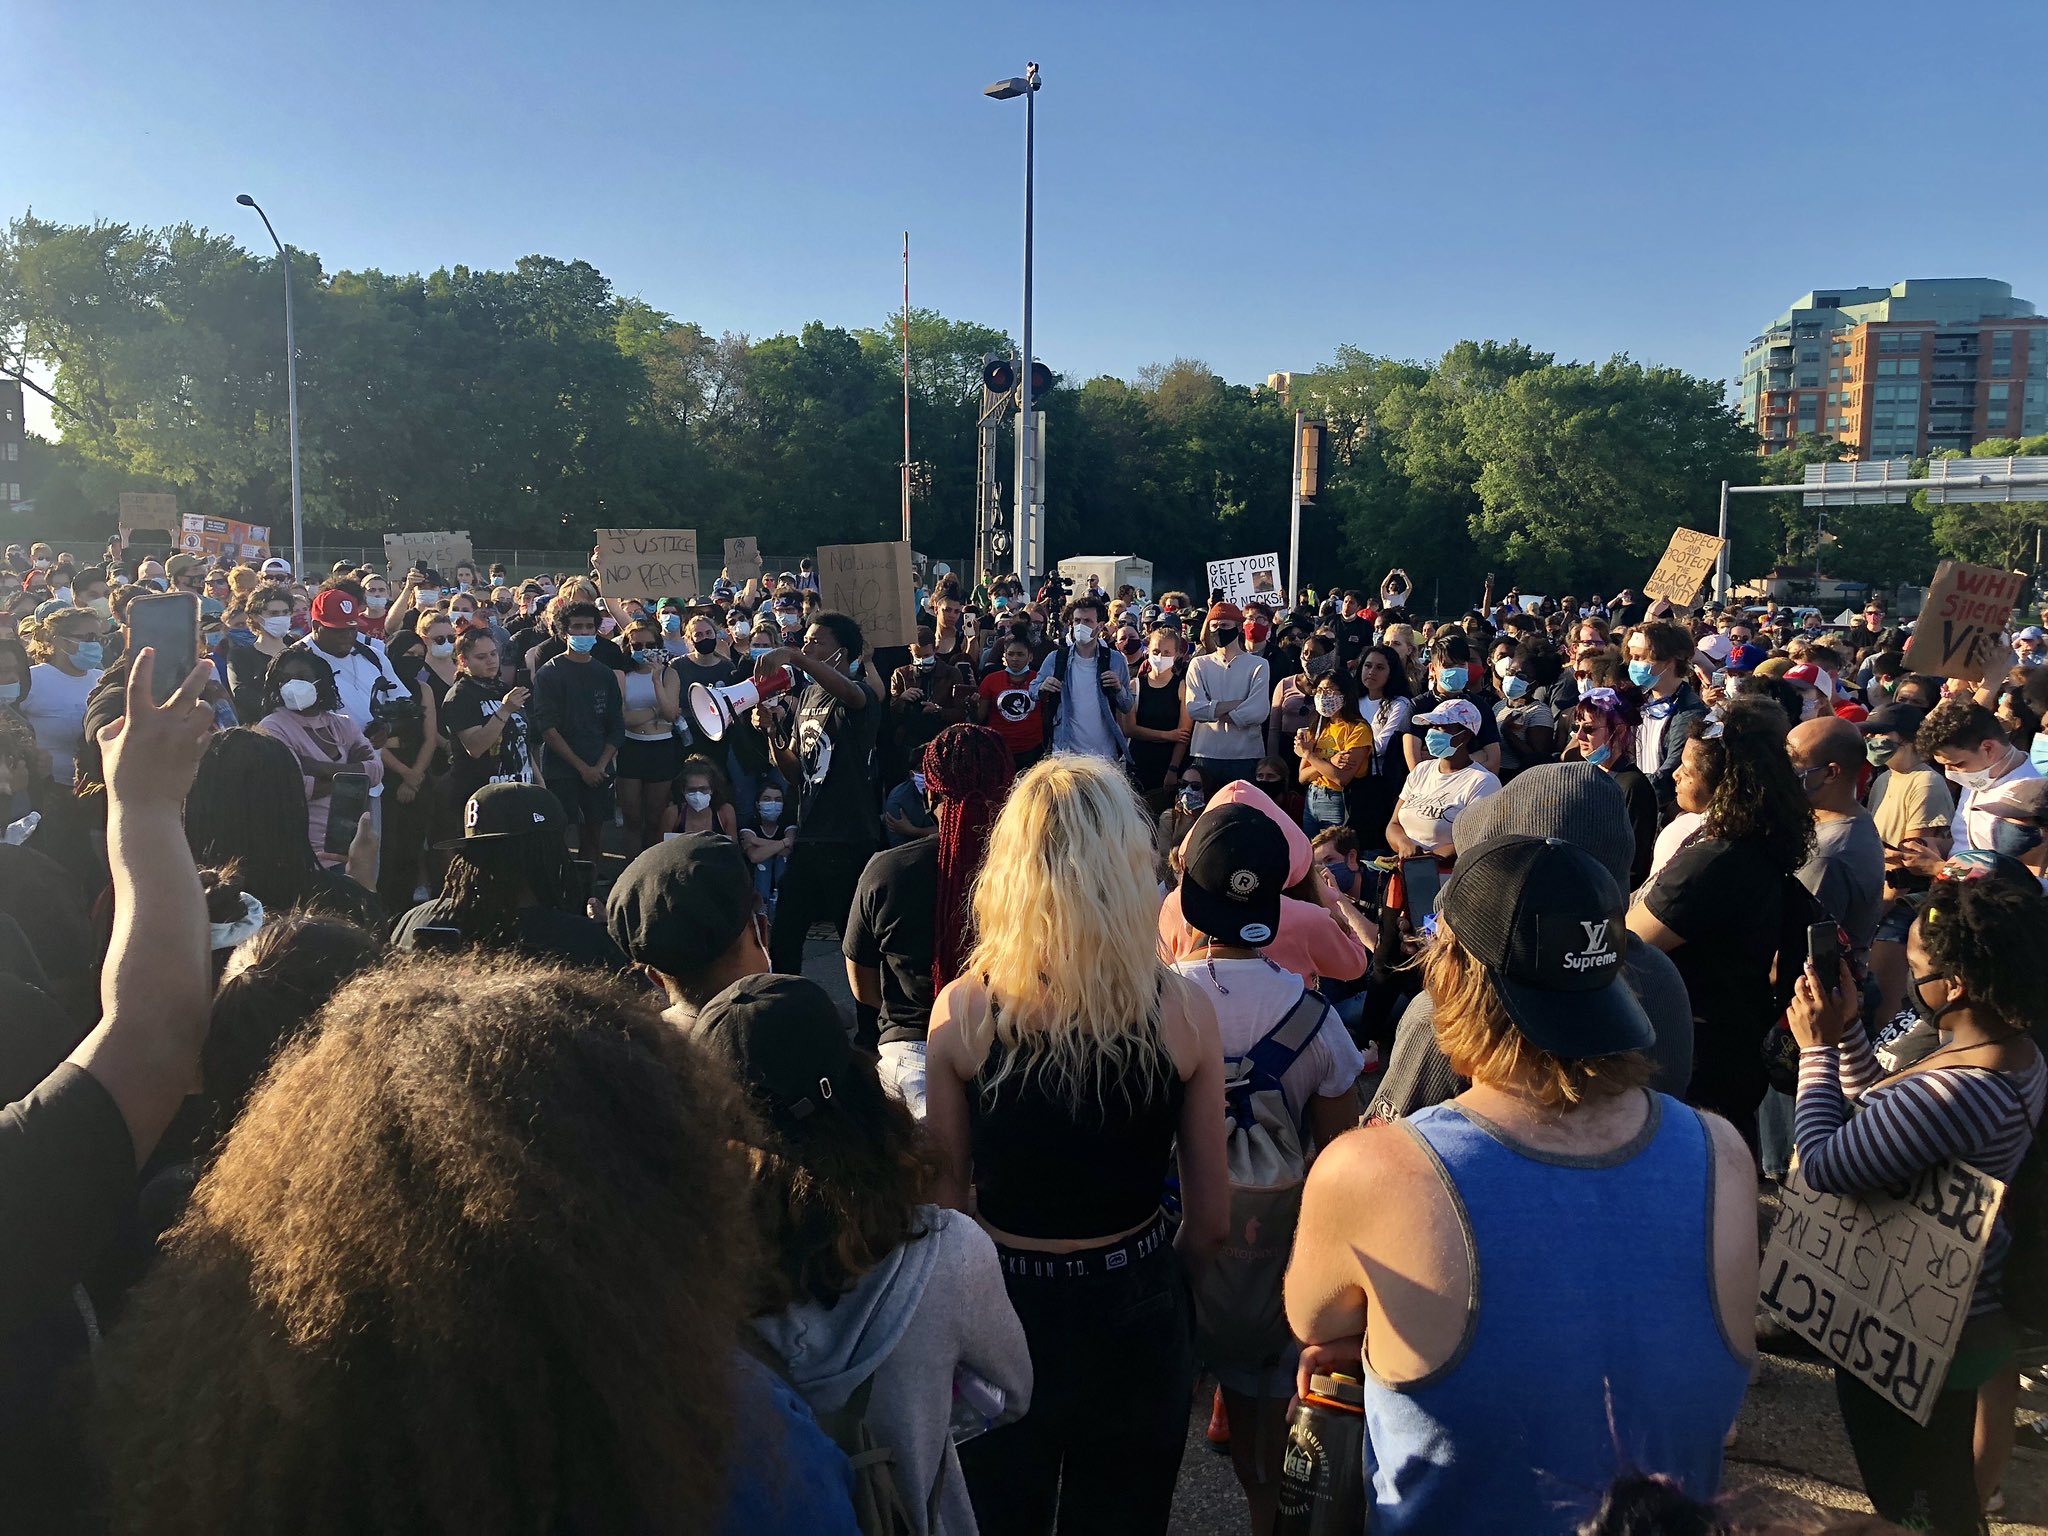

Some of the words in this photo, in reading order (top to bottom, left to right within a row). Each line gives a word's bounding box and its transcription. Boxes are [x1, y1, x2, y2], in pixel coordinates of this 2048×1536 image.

[403, 535, 448, 545] BLACK
[608, 536, 695, 555] JUSTICE
[1675, 529, 1725, 552] RESPECT
[1684, 545, 1702, 555] AND
[407, 548, 453, 561] LIVES
[1663, 547, 1714, 571] PROTECT
[606, 565, 631, 584] NO
[1209, 562, 1235, 576] GET
[1240, 556, 1275, 571] YOUR
[1676, 565, 1691, 575] THE
[1211, 572, 1246, 588] KNEE
[1651, 568, 1698, 592] BLACK
[833, 578, 881, 617] NO
[464, 799, 480, 828] B
[1238, 875, 1251, 888] R
[1563, 952, 1617, 972] Supreme
[1926, 1232, 1972, 1289] OR
[1760, 1260, 1936, 1411] RESPECT
